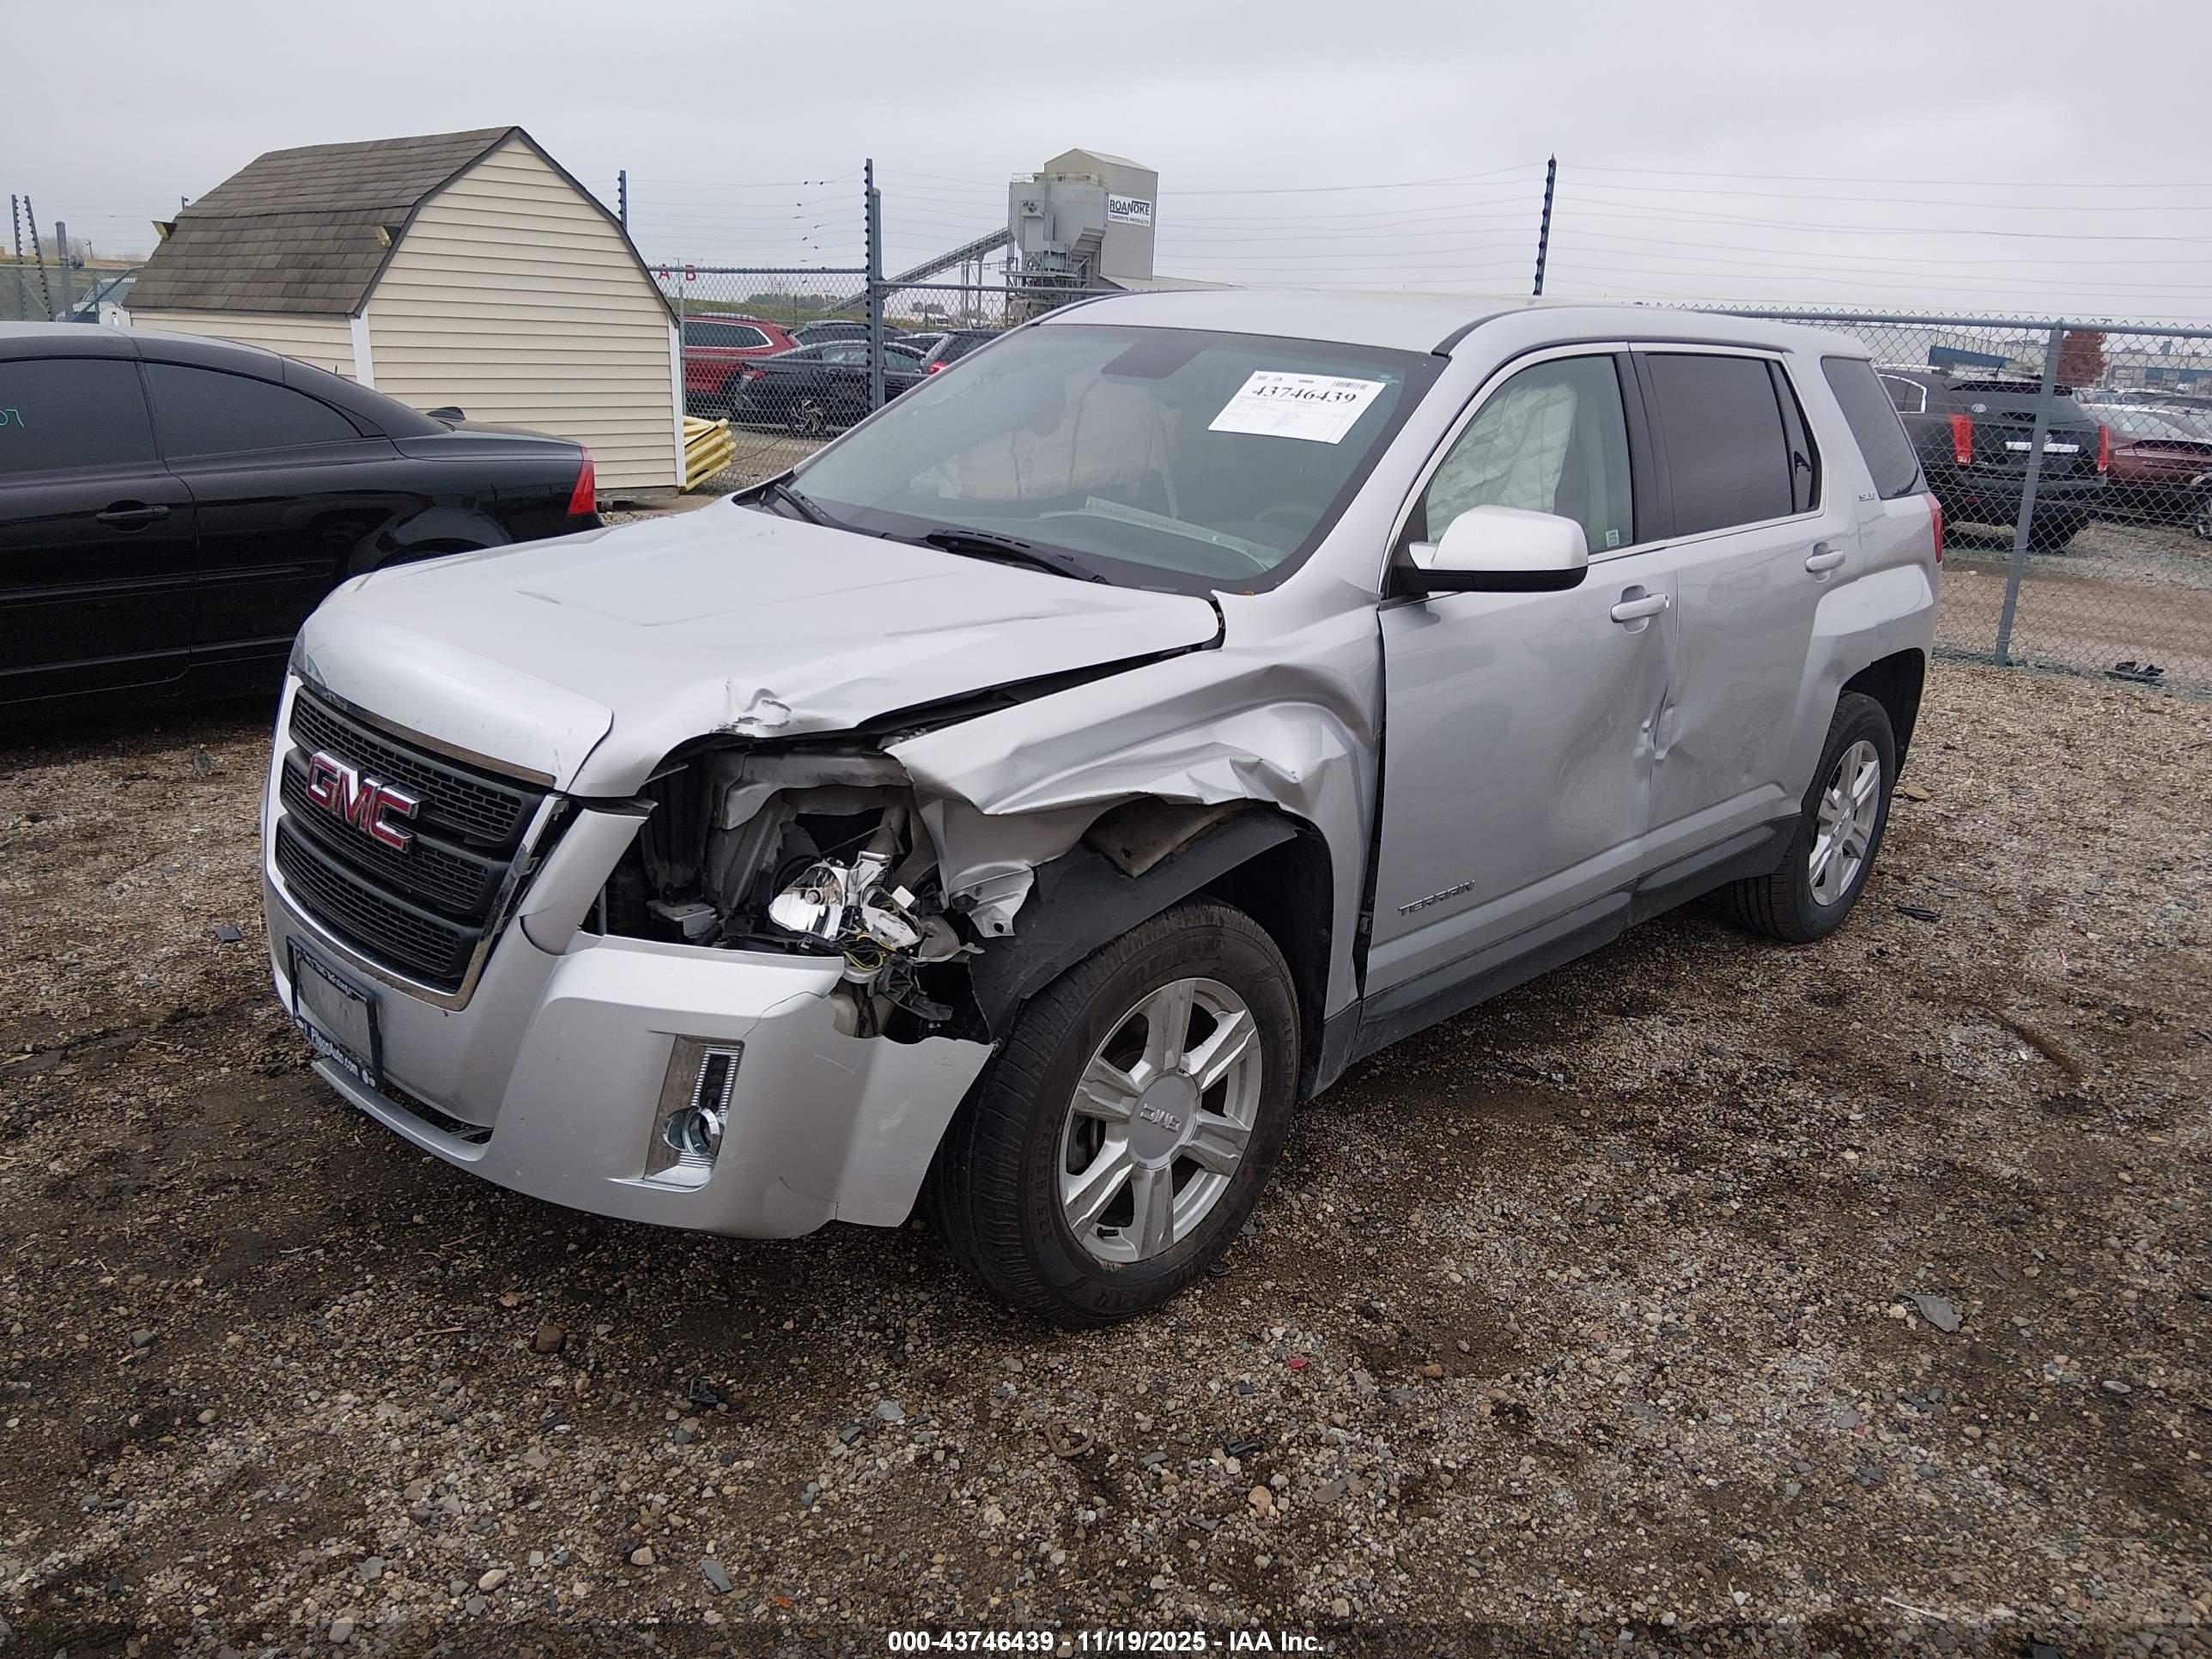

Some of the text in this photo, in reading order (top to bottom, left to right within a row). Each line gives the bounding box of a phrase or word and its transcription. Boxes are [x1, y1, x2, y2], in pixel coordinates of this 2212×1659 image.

[1109, 199, 1151, 216] ROANOKE
[659, 264, 696, 281] A B
[1253, 385, 1357, 404] 43746439
[306, 751, 420, 854] GMC
[1398, 879, 1475, 917] TERRAIN
[1140, 1103, 1182, 1132] GMC
